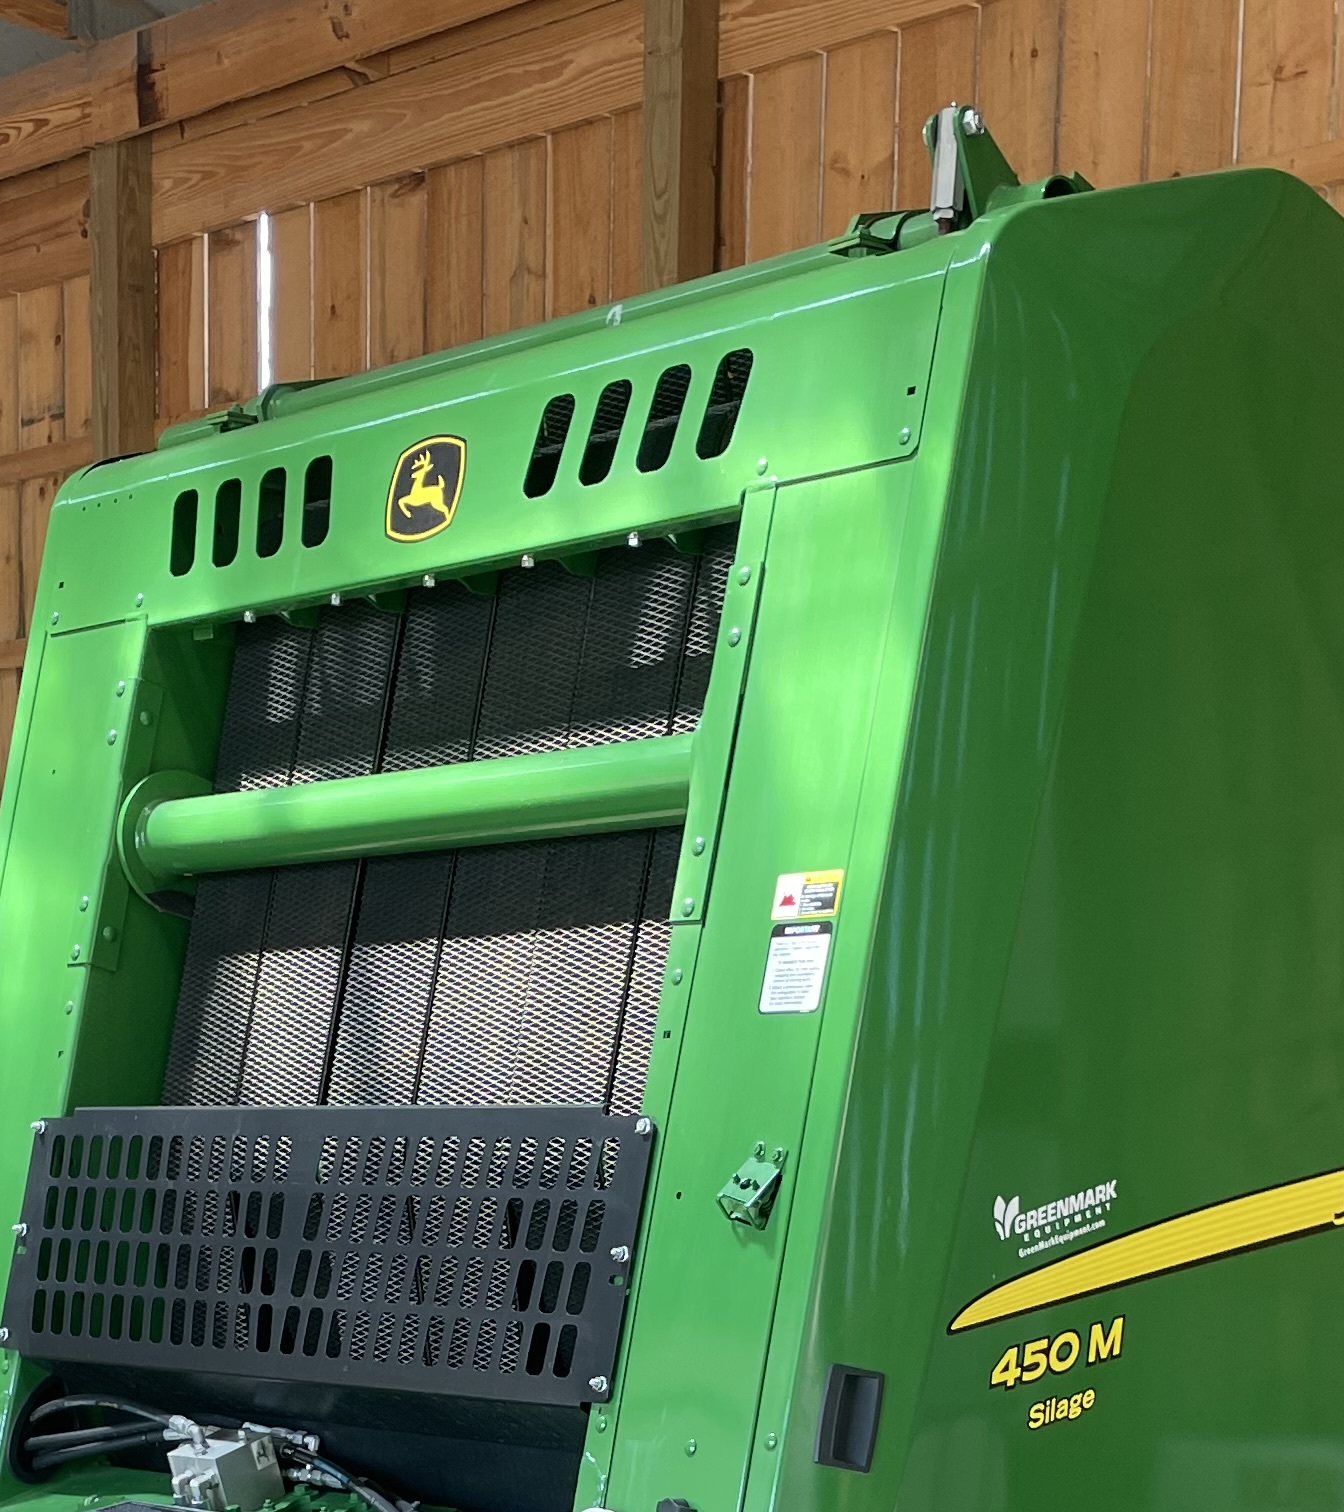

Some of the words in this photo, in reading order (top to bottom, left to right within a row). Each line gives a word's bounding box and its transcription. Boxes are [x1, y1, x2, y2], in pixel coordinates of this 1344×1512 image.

[1014, 1179, 1117, 1235] GREENMARK
[1023, 1202, 1111, 1242] EQUIPMENT
[989, 1330, 1081, 1390] 450
[1086, 1314, 1126, 1367] M
[1027, 1388, 1096, 1430] Silage
